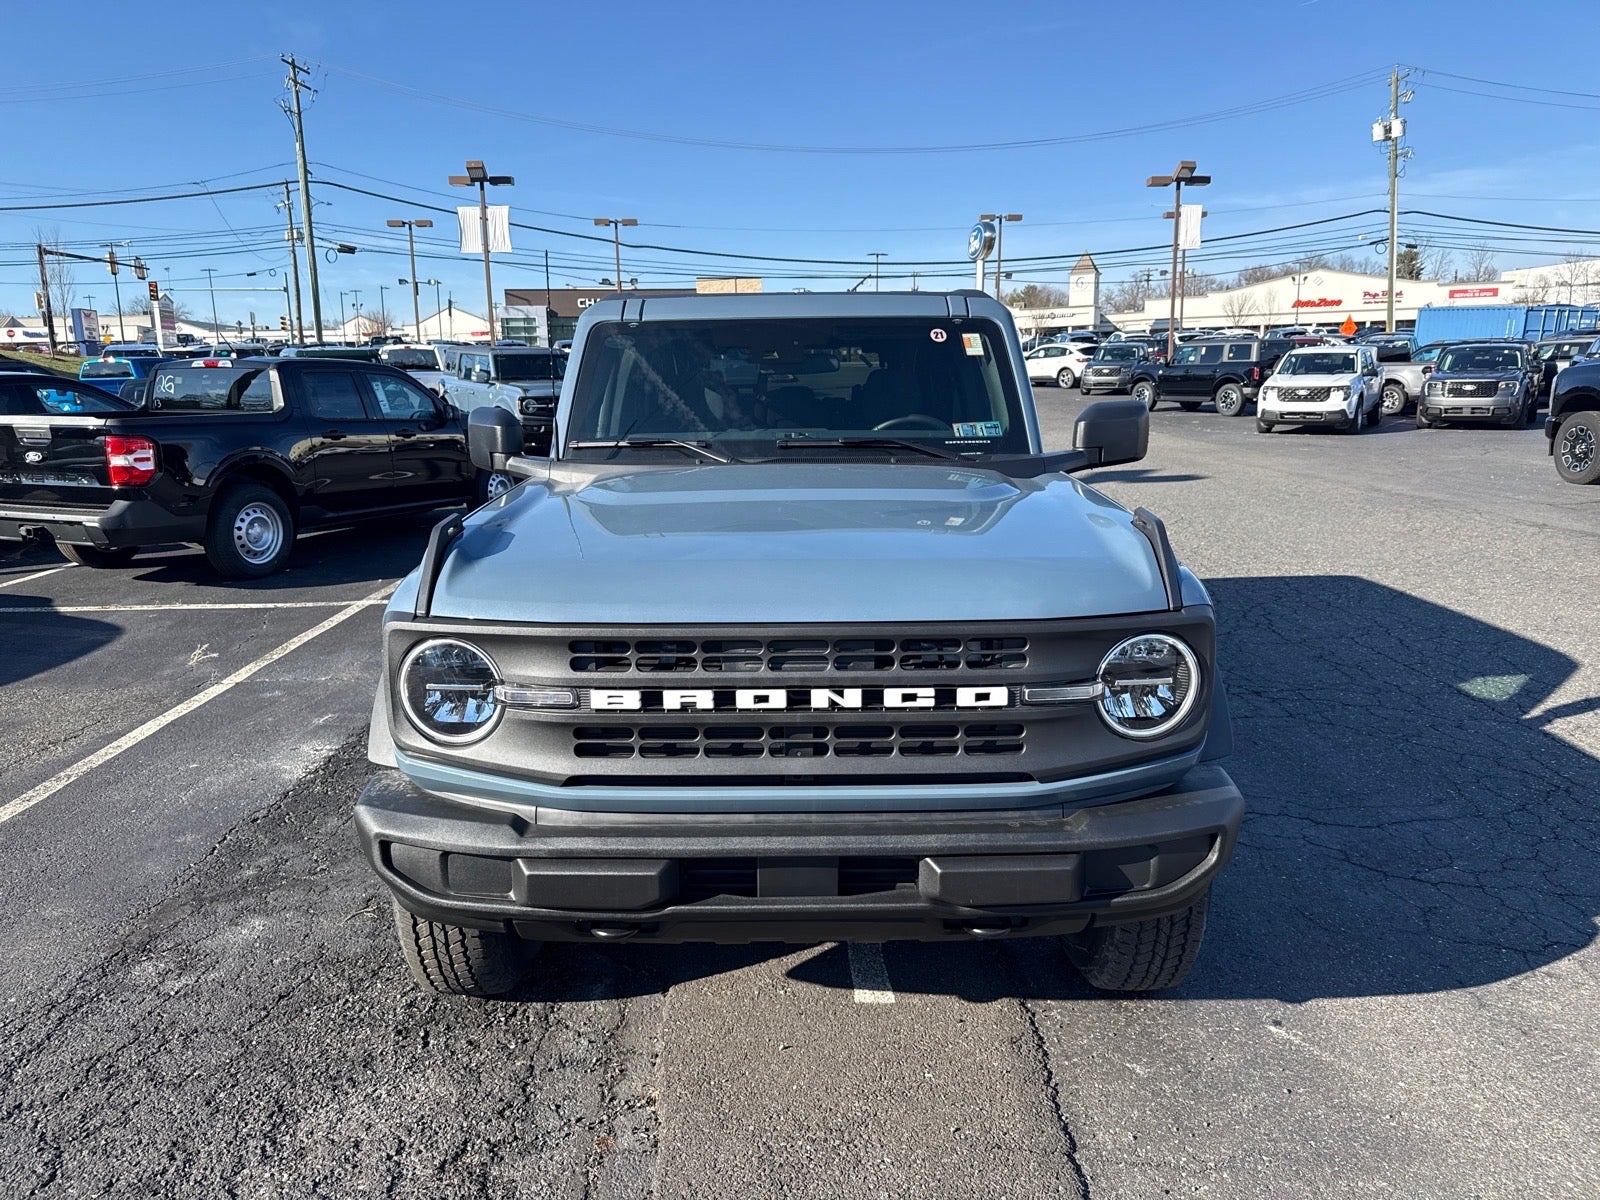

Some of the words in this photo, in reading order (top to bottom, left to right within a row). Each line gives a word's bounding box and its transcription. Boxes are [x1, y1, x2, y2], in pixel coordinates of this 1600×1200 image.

[1291, 297, 1343, 308] AutoZone
[933, 331, 944, 339] 21
[156, 374, 175, 395] 26
[590, 686, 1009, 710] BRONCO
